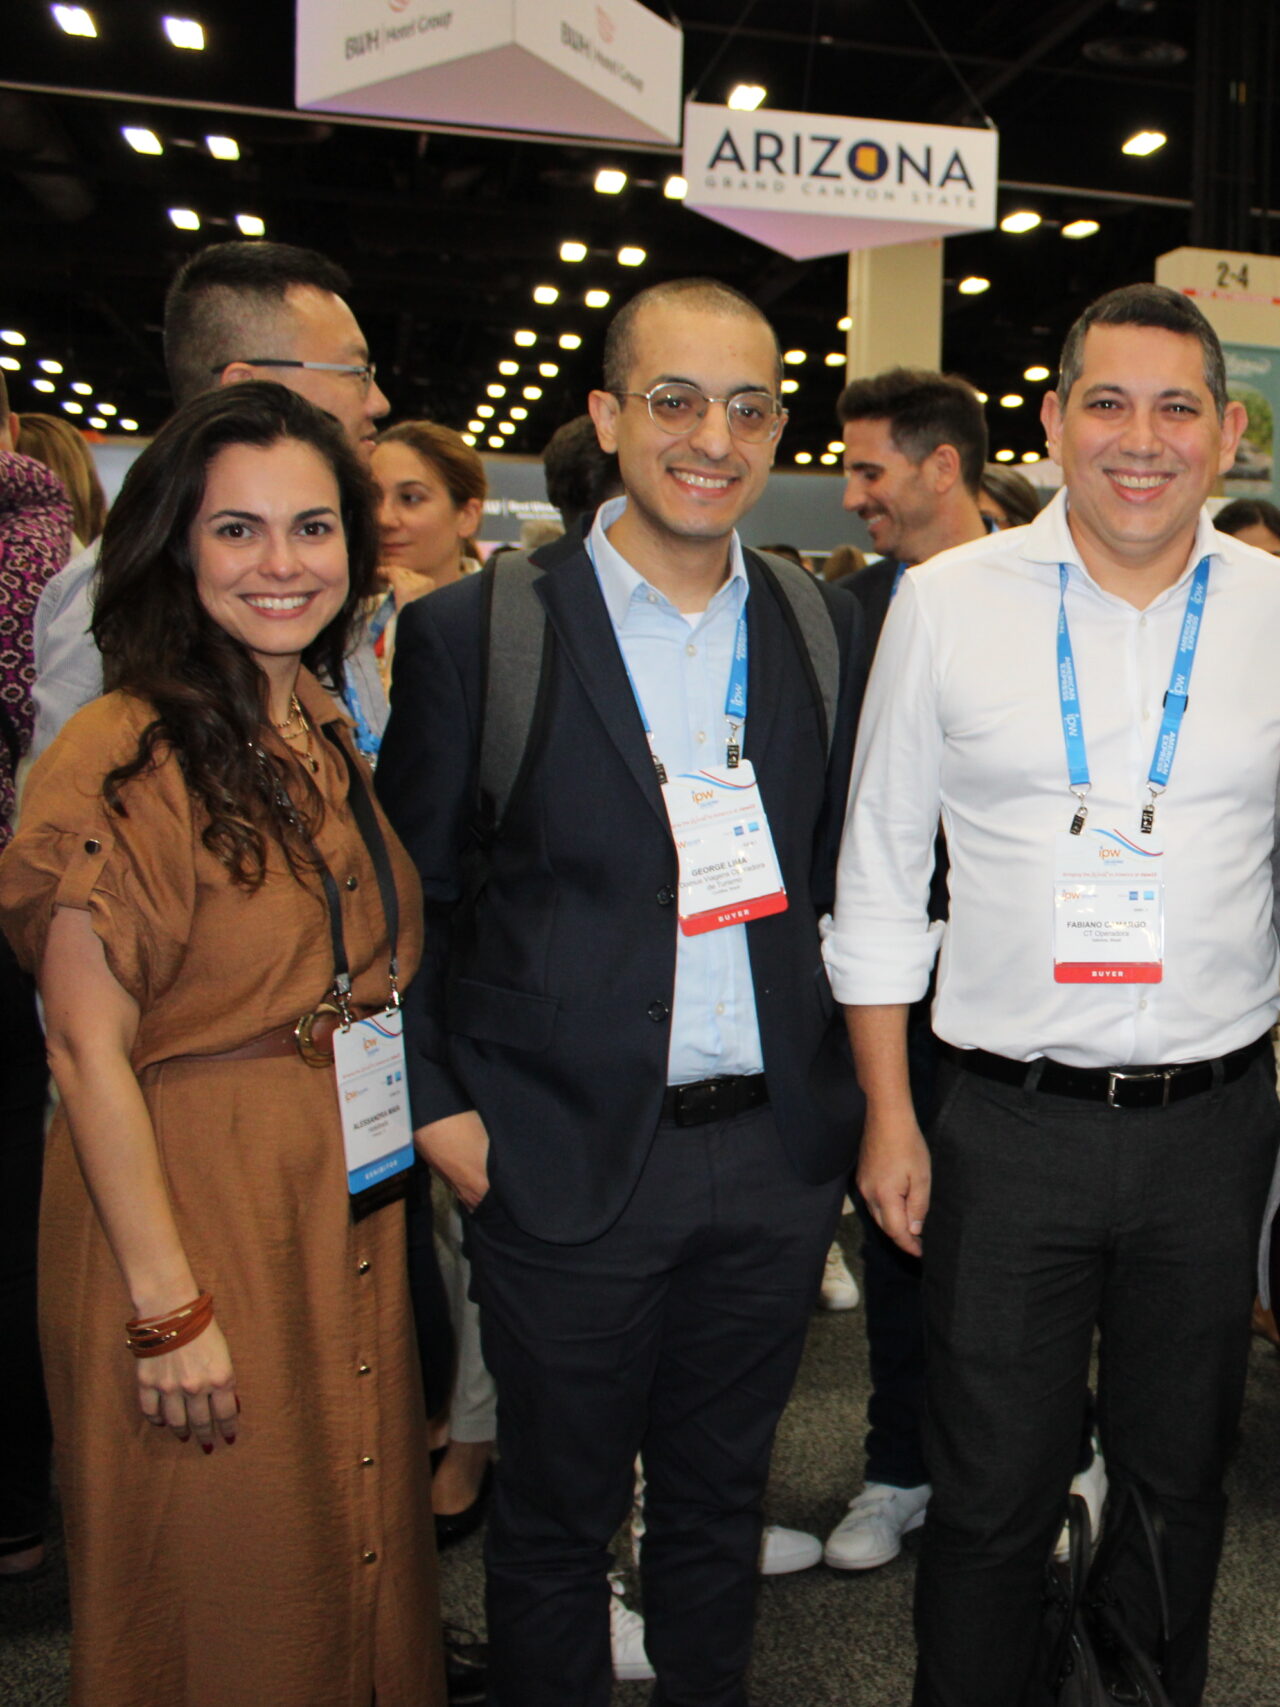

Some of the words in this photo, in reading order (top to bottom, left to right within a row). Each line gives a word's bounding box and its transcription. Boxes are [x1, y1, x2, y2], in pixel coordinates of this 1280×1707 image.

[707, 128, 975, 191] ARIZONA
[705, 177, 785, 193] GRAND
[801, 183, 896, 202] CANYON
[911, 191, 977, 209] STATE
[1216, 261, 1249, 288] 2-4
[1063, 713, 1080, 737] ipw
[1099, 846, 1122, 860] ipw
[691, 862, 726, 877] GEORGE
[717, 909, 750, 923] BUYER
[1066, 921, 1102, 929] FABIANO
